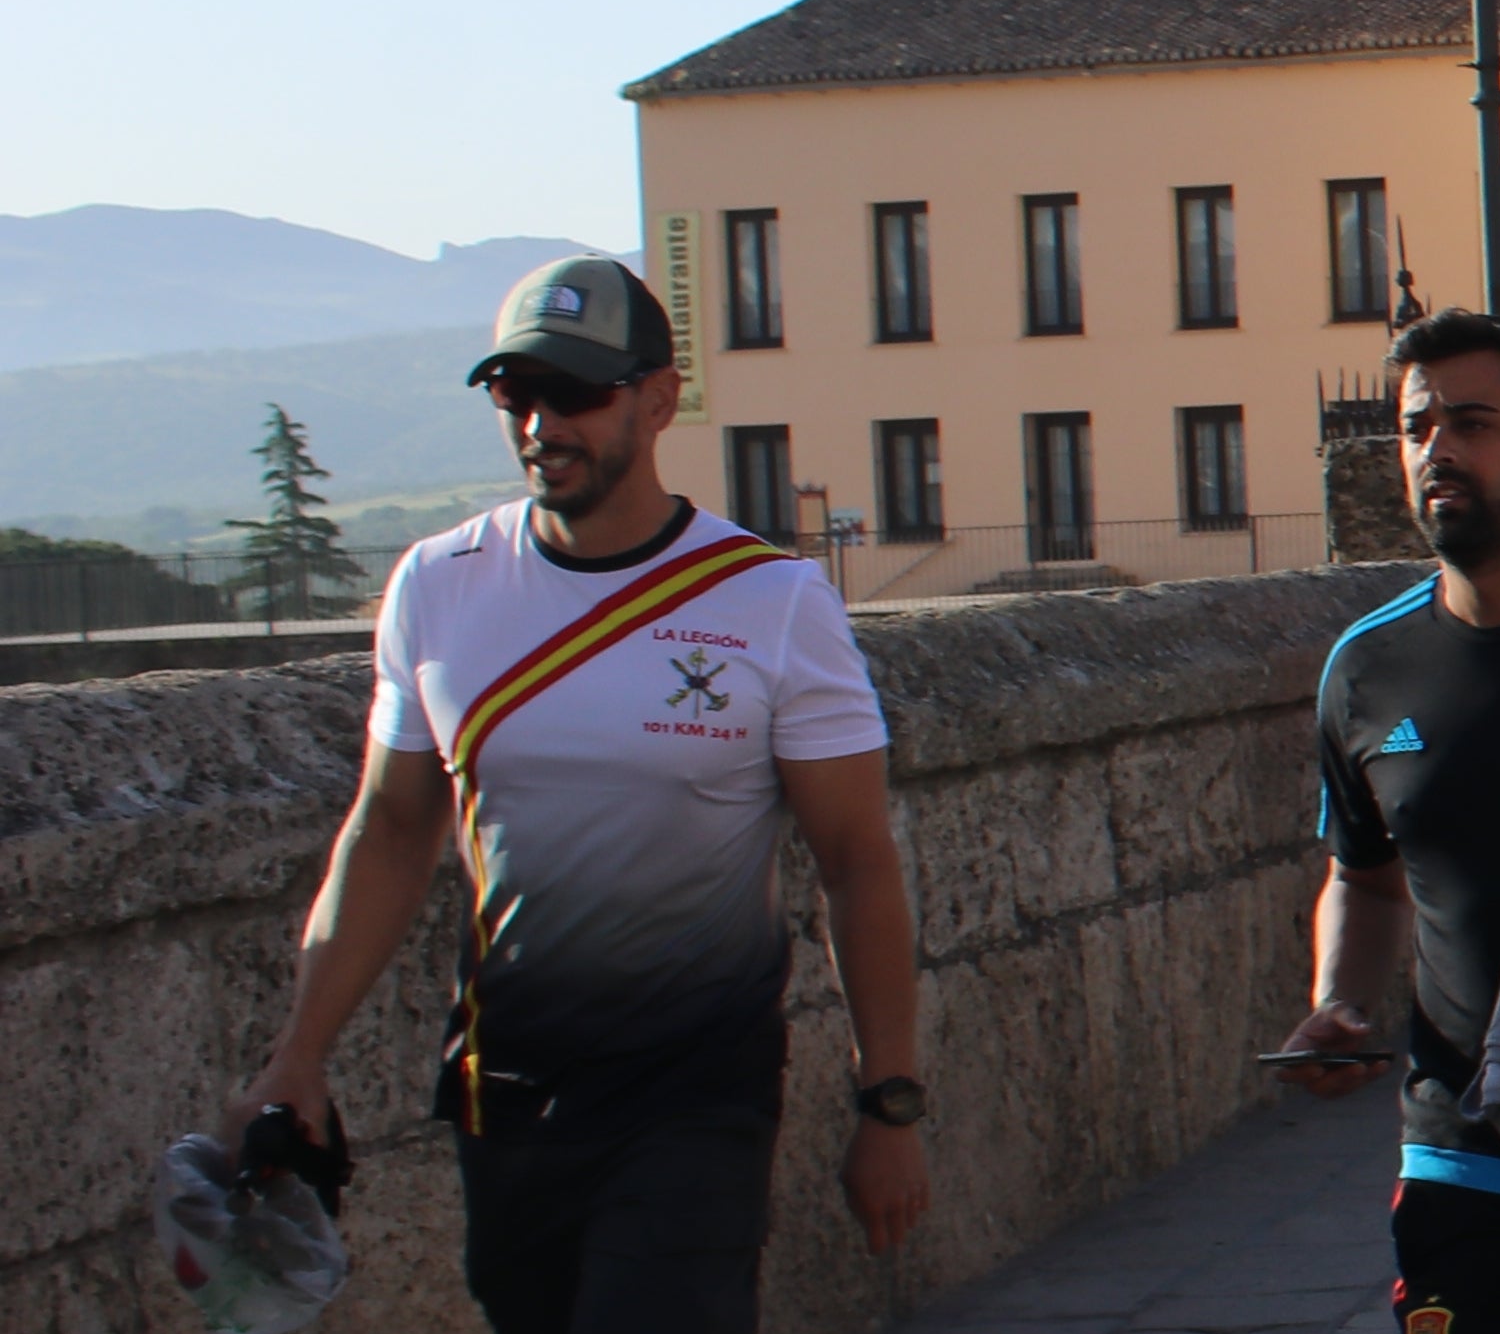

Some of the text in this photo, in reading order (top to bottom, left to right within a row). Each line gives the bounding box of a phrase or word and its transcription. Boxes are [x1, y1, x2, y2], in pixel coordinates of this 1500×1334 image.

[653, 629, 748, 649] LA LEGIÓN
[643, 722, 747, 741] 101 KM 24 H
